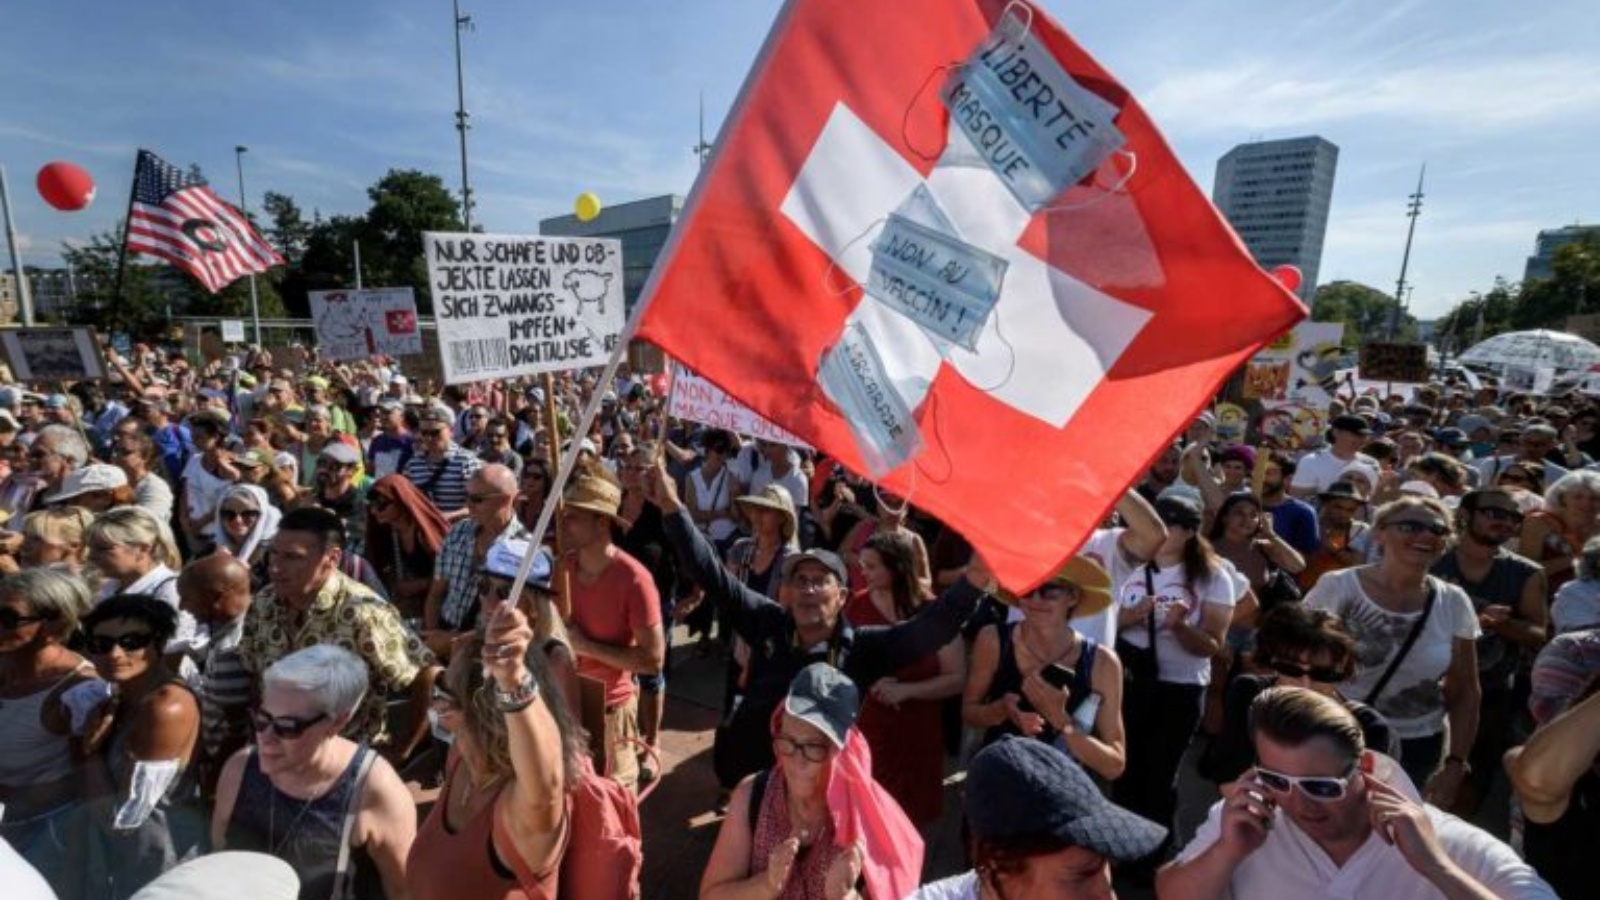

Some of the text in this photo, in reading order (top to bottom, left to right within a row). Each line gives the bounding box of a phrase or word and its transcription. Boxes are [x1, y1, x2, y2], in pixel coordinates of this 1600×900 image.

[949, 82, 1030, 182] MASQUE
[434, 238, 478, 264] NUR
[551, 242, 581, 265] UND
[886, 235, 970, 284] NON AU
[436, 265, 551, 291] JEKTE LASSEN
[440, 294, 479, 320] SICH
[676, 380, 713, 402] NON
